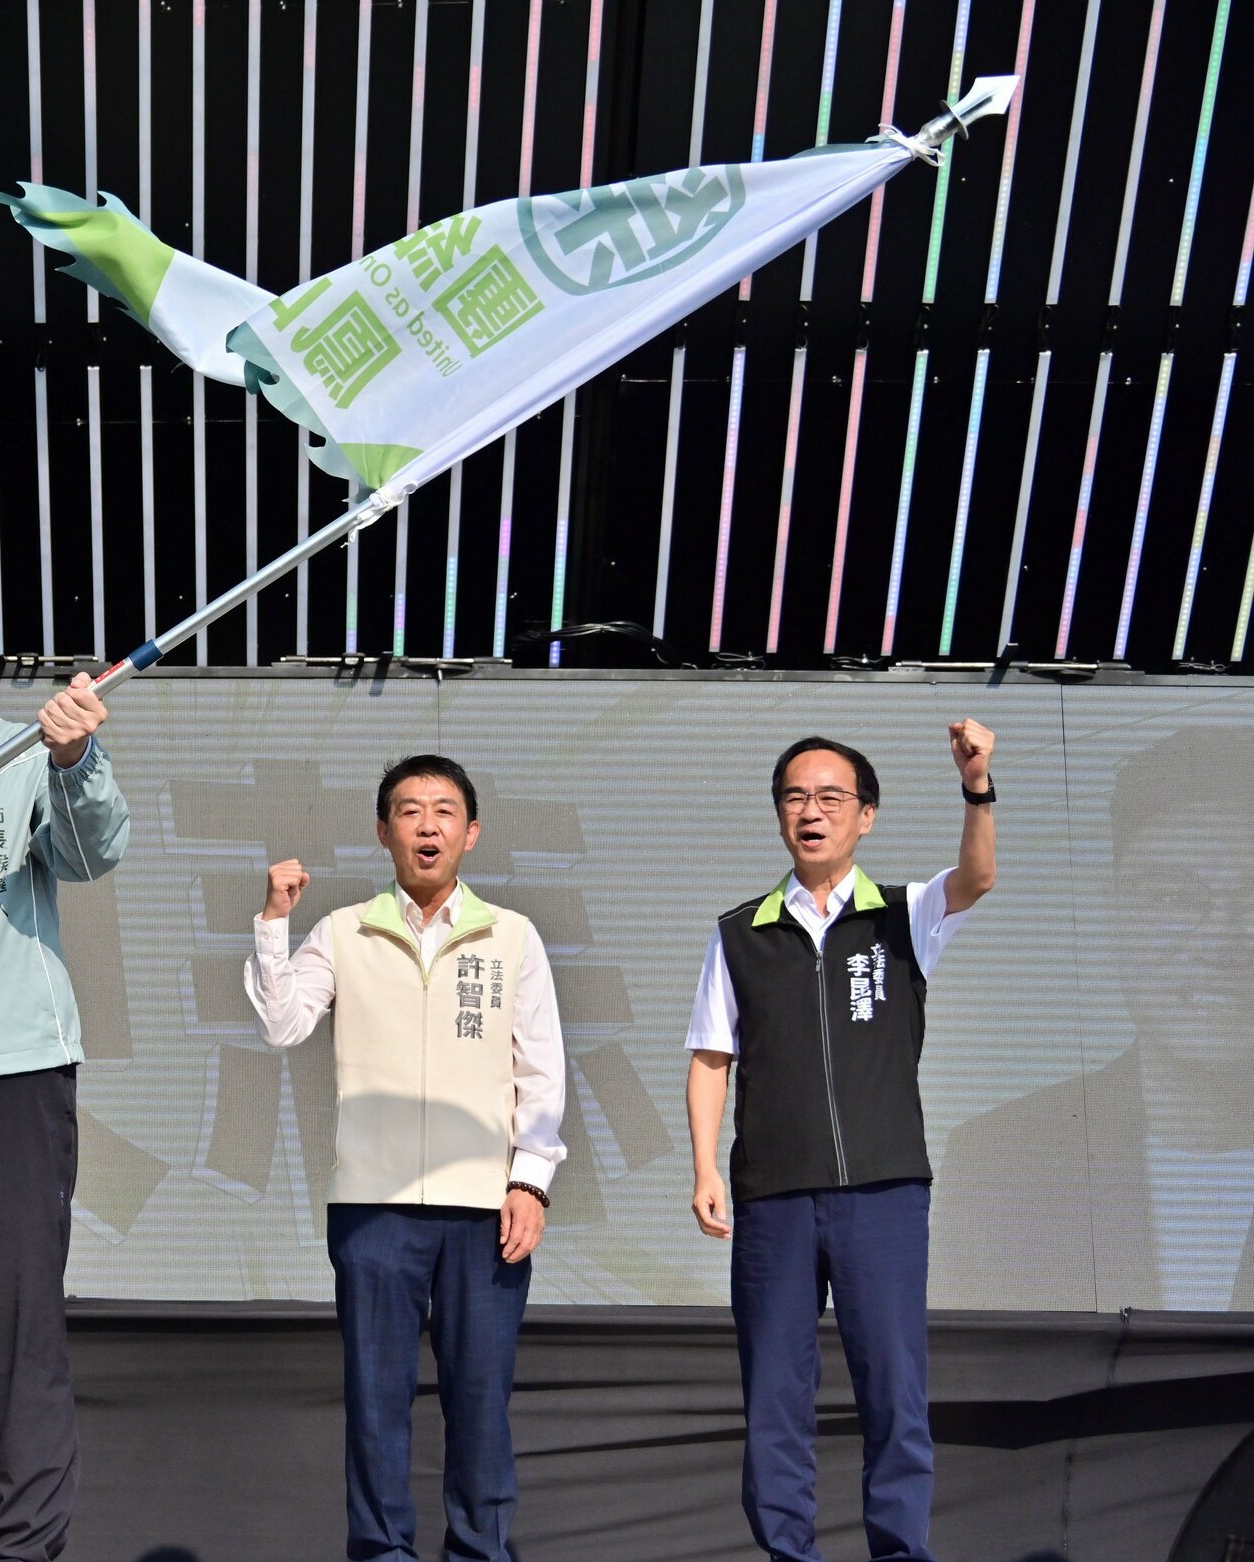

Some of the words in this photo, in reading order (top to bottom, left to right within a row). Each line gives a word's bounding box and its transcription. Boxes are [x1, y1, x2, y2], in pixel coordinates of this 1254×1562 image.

[455, 953, 485, 1040] 許智傑
[490, 959, 504, 1010] 立法委員
[847, 953, 874, 1022] 李昆澤
[870, 943, 887, 1002] 立法委員
